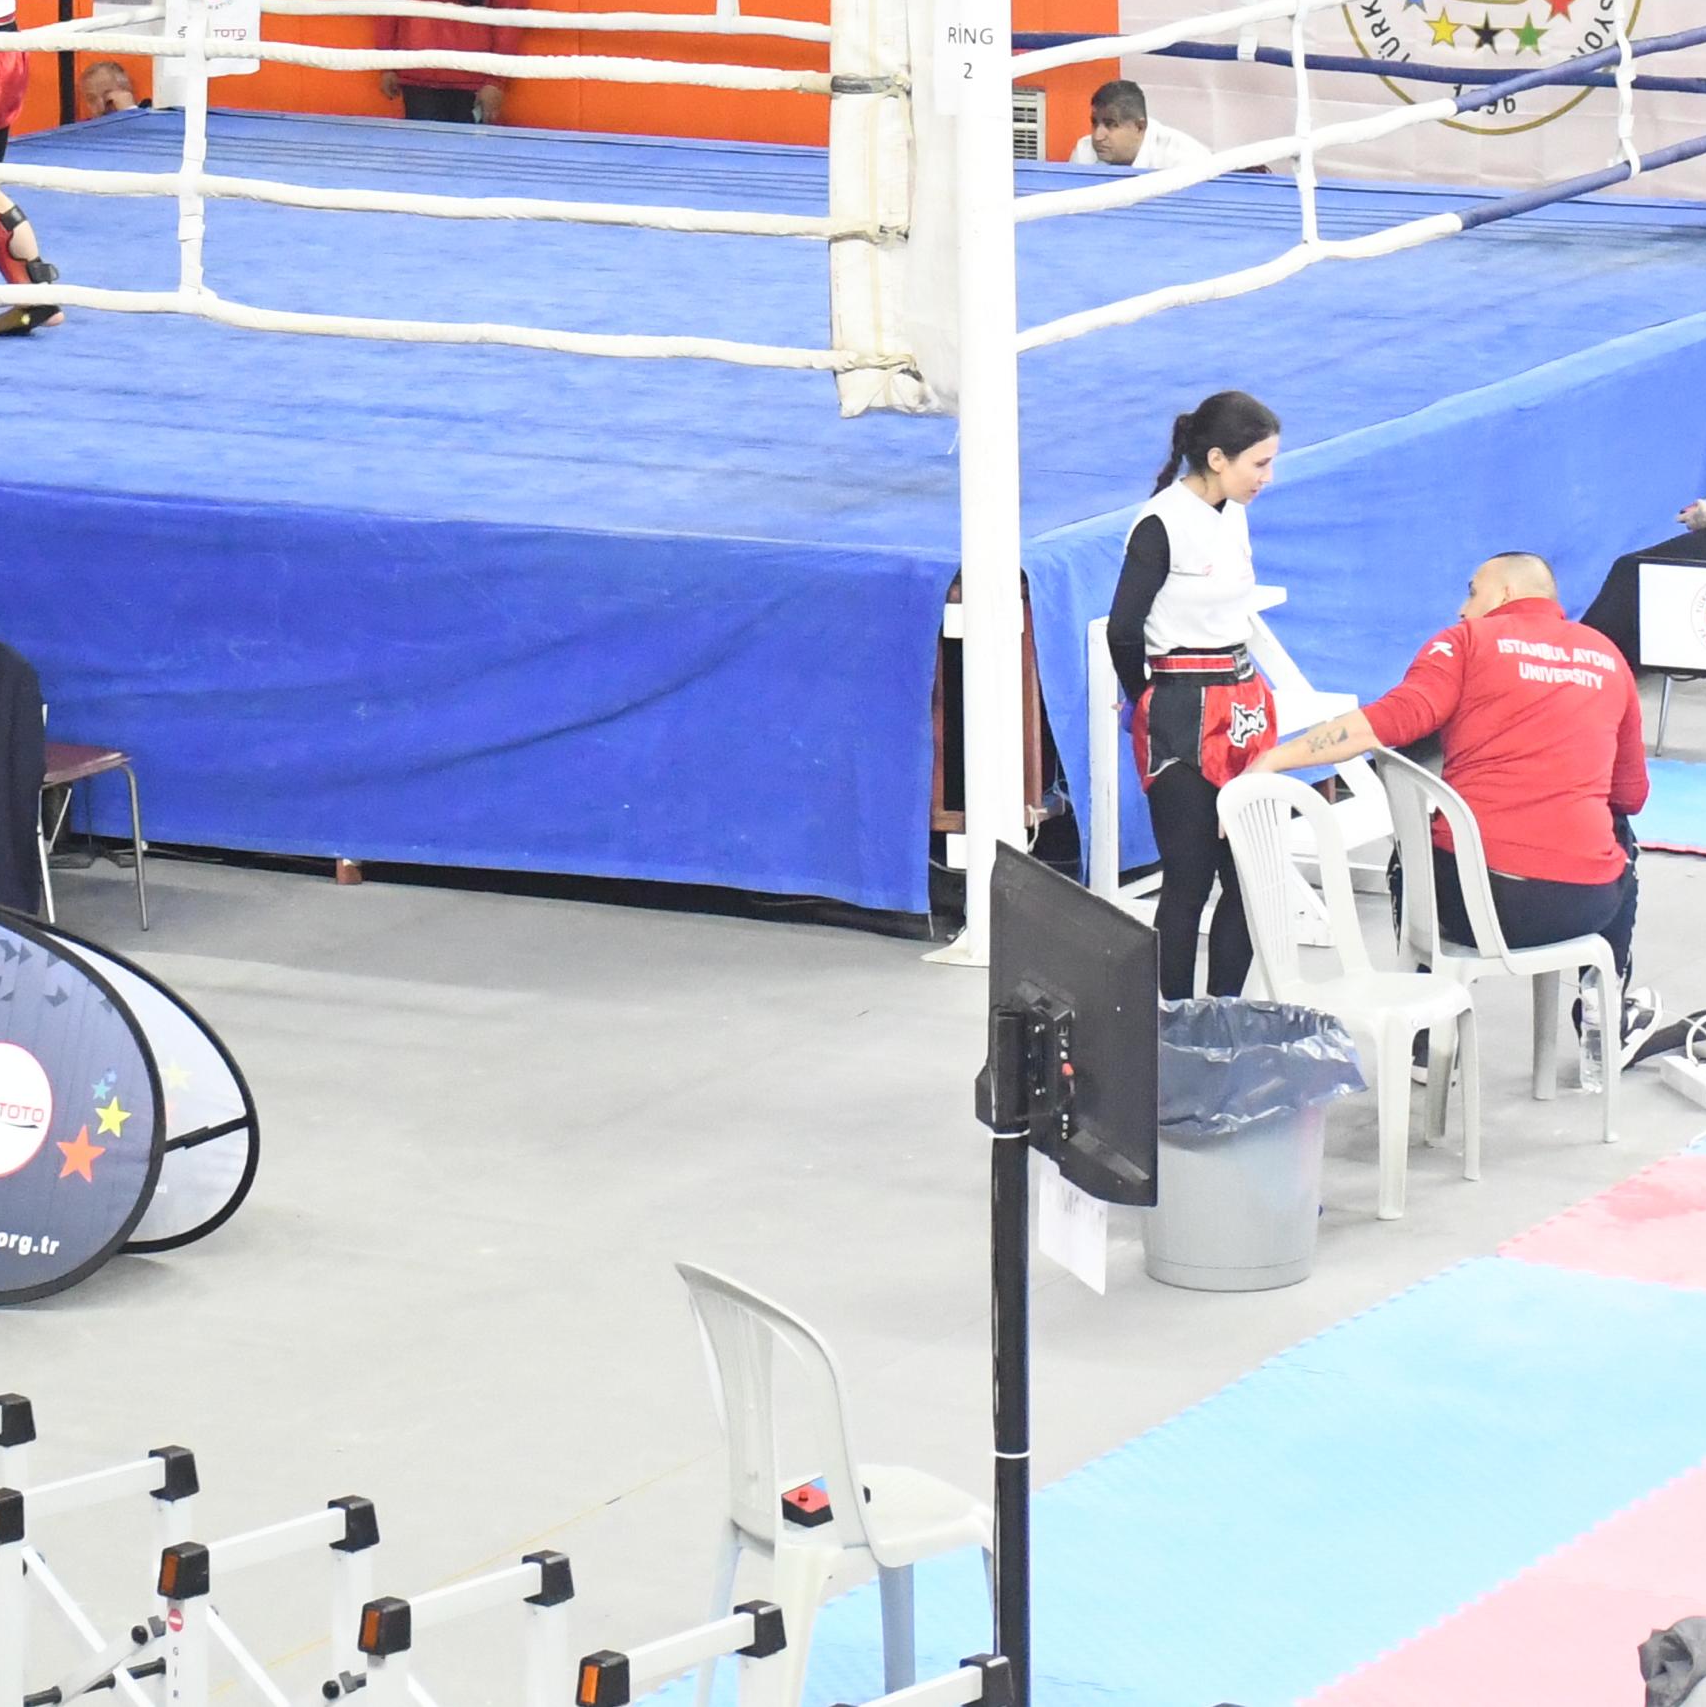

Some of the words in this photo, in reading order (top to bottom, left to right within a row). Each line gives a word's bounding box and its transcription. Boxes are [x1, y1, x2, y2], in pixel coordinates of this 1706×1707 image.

[948, 22, 994, 45] RİNG
[963, 62, 973, 79] 2
[1572, 647, 1616, 673] AYDIN
[1518, 661, 1603, 690] UNIVERSITY
